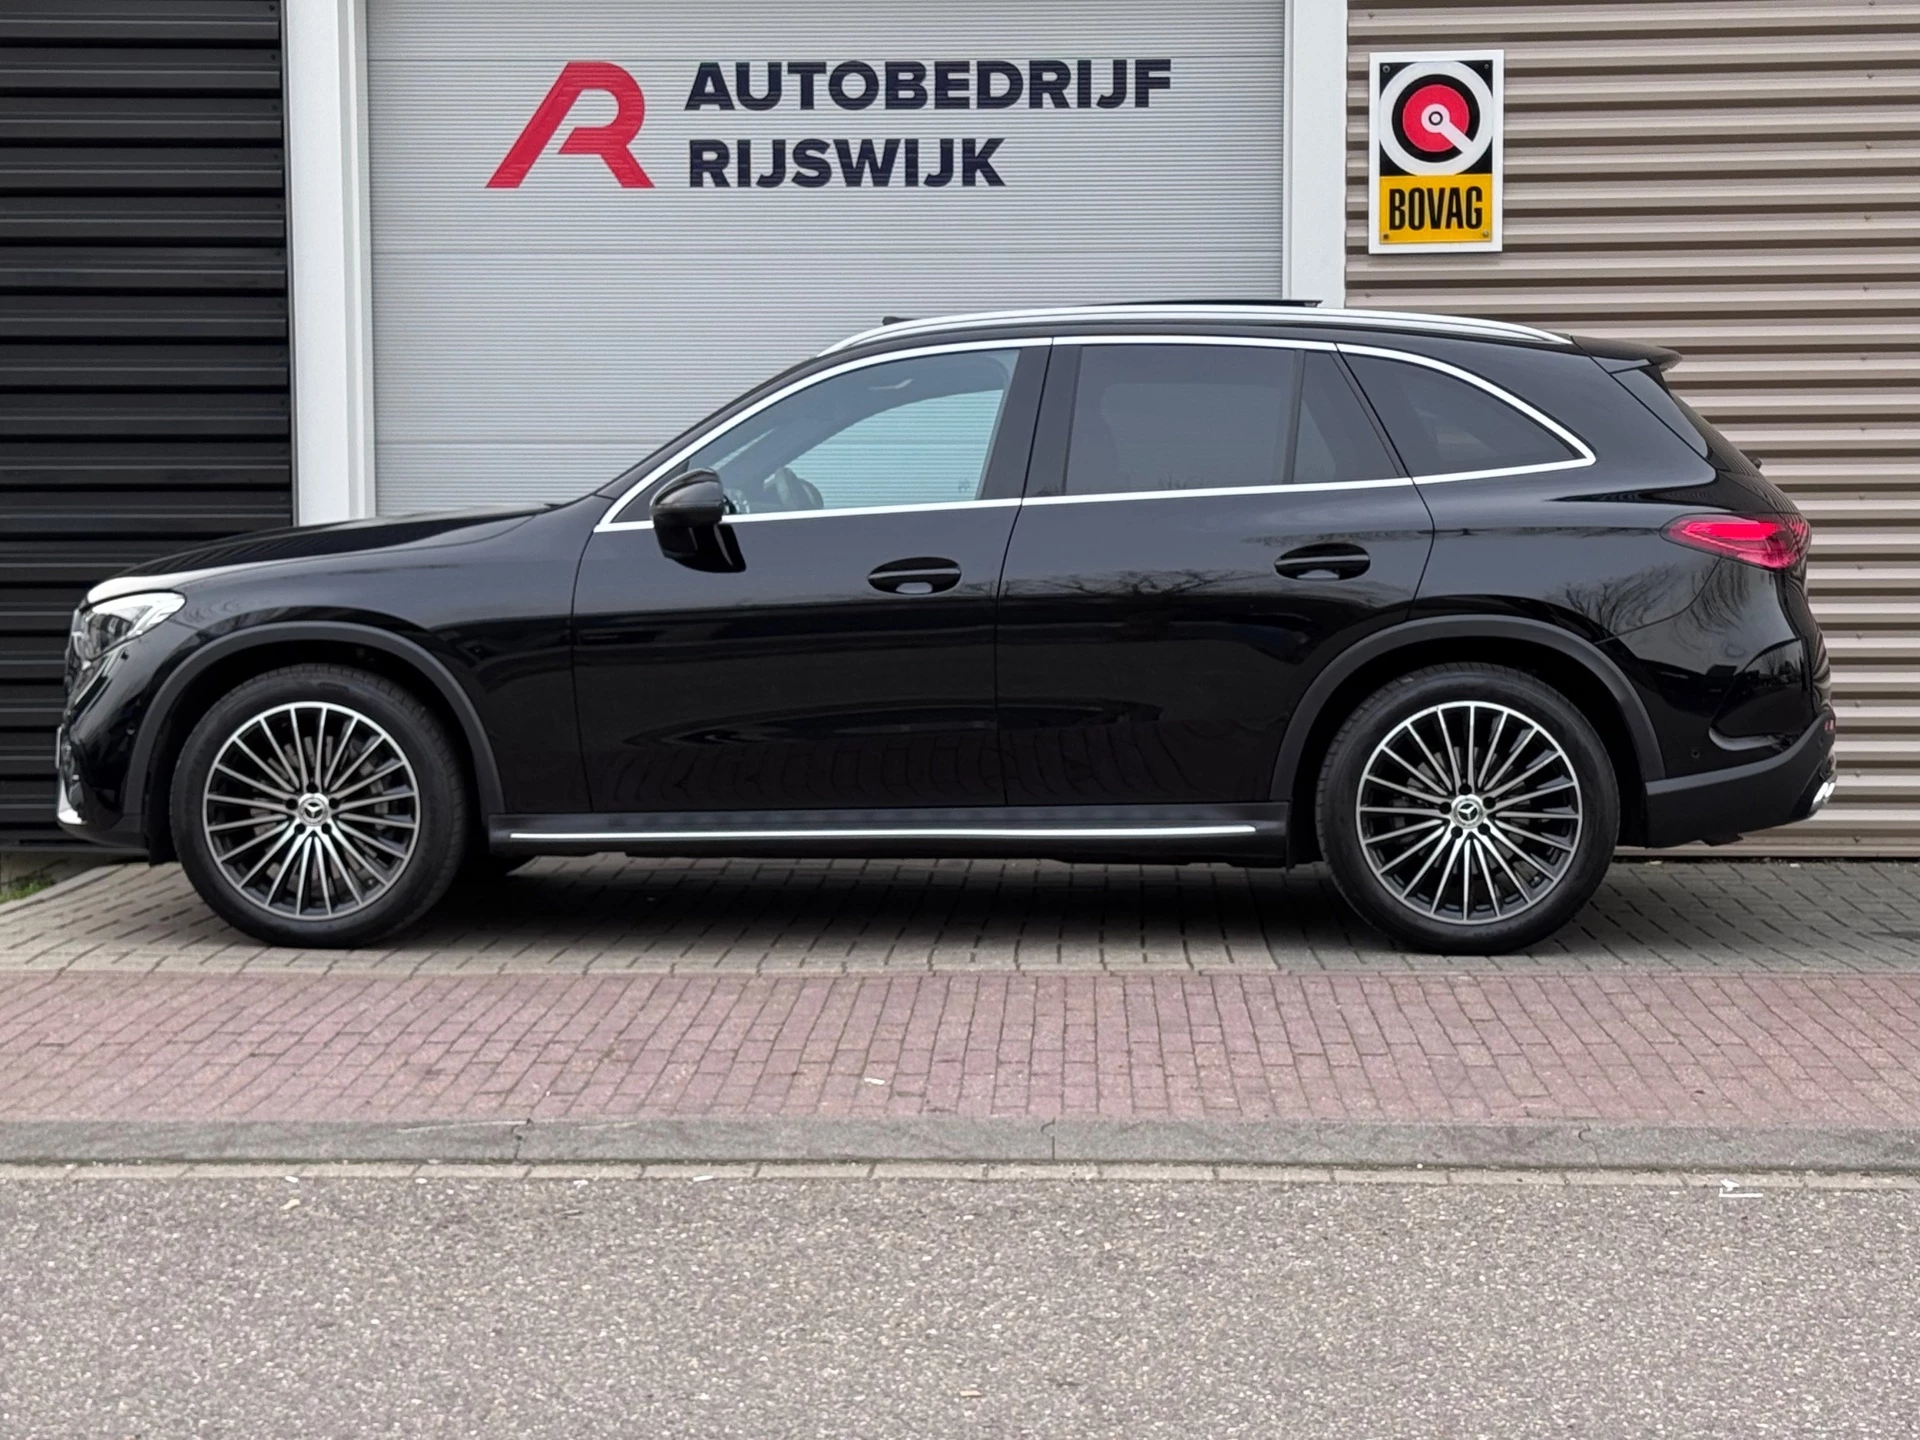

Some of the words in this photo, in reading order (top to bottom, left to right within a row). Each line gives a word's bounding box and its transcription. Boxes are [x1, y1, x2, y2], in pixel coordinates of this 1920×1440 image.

[684, 58, 1172, 111] AUTOBEDRIJF
[688, 137, 1006, 189] RIJSWIJK
[1388, 186, 1483, 231] BOVAG
